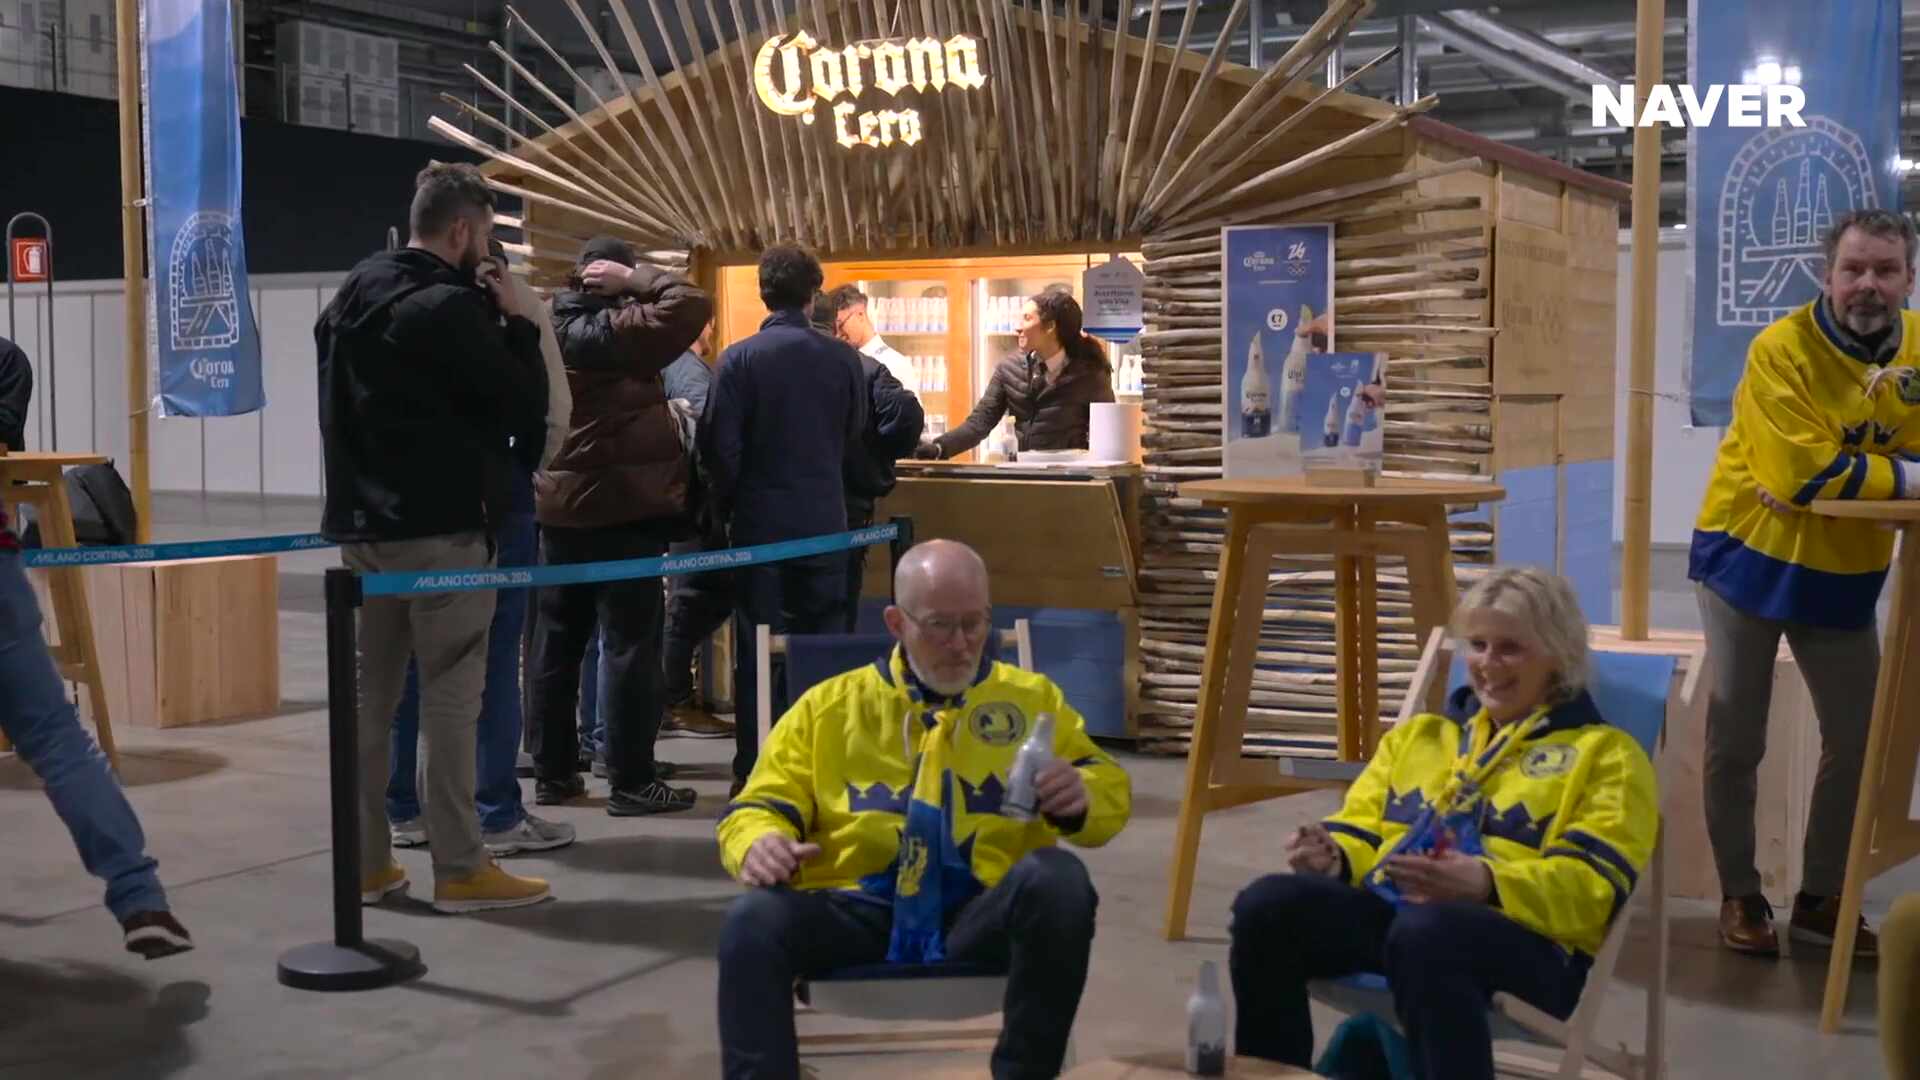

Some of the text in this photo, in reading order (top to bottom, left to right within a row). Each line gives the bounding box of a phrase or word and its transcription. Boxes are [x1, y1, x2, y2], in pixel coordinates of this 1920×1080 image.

[754, 30, 987, 125] Corona
[833, 101, 922, 148] Cero
[32, 550, 82, 564] MILANO
[82, 550, 130, 562] CORTINA
[660, 556, 698, 571] MILANO
[699, 552, 734, 568] CORTINA
[412, 575, 462, 589] MILANO
[463, 573, 510, 586] CORTINA
